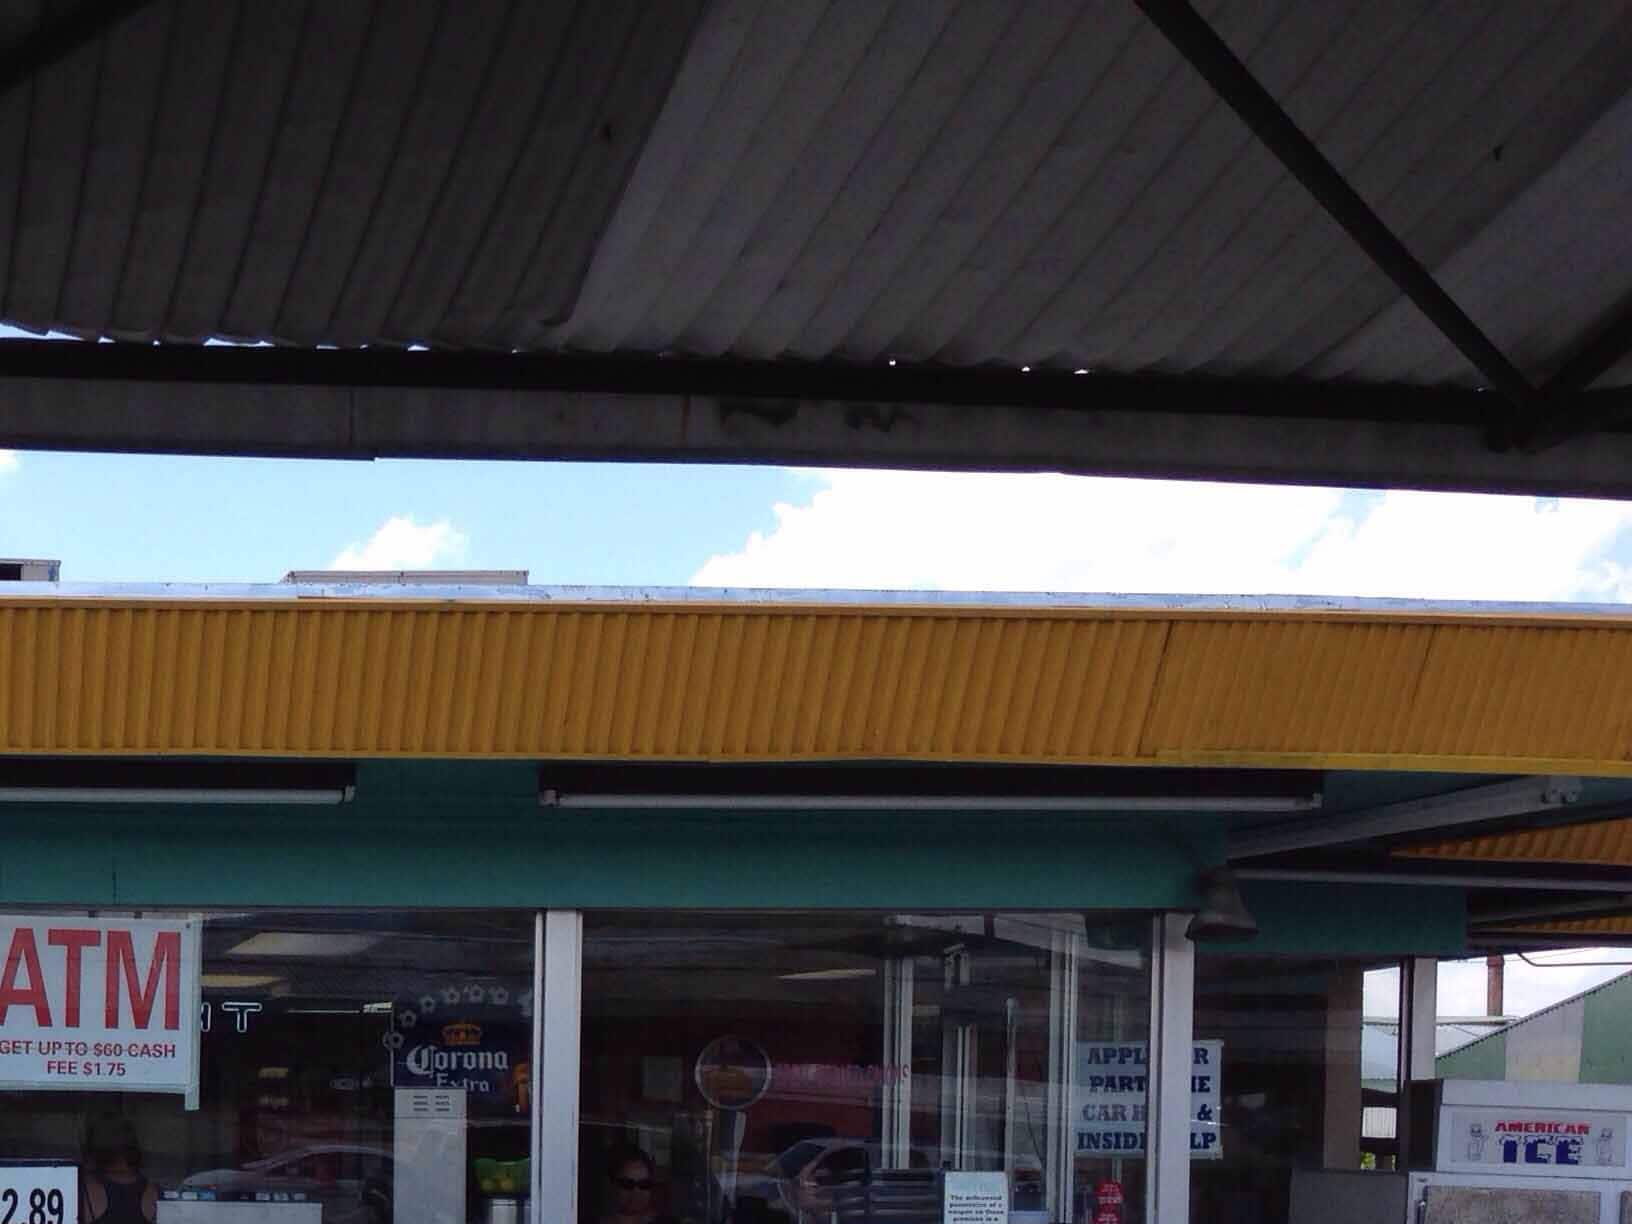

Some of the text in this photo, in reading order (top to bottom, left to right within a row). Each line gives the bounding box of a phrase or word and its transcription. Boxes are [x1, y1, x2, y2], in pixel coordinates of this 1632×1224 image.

[39, 1042, 62, 1056] UP
[68, 1042, 88, 1056] TO
[94, 1043, 122, 1057] $60
[128, 1044, 176, 1058] CASH
[48, 1061, 126, 1076] FEE $1.75
[407, 1045, 508, 1078] Corona
[1083, 1104, 1126, 1121] CAR
[1495, 1120, 1591, 1135] AMERICAN
[1499, 1135, 1583, 1165] ICE
